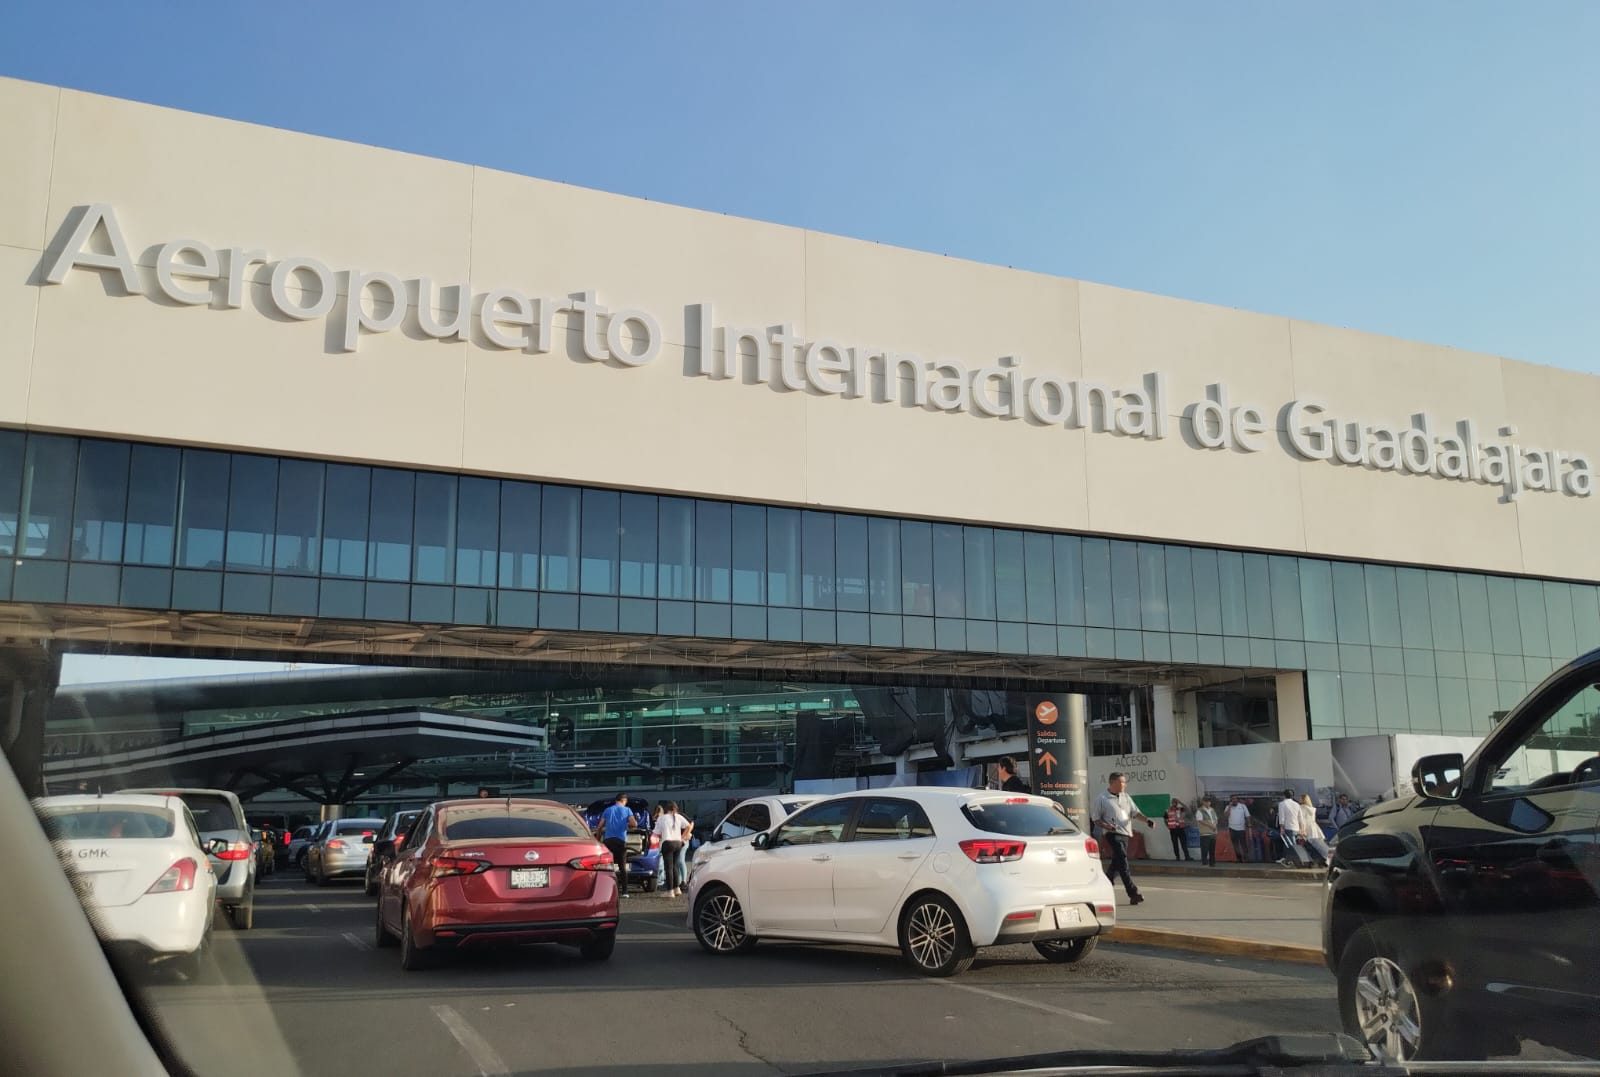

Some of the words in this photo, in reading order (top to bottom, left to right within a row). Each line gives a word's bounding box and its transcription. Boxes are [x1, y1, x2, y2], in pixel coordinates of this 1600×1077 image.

[45, 202, 661, 367] Aeropuerto
[698, 303, 1166, 440] Internacional
[1191, 382, 1267, 451] de
[1286, 400, 1591, 502] Guadalajara
[1115, 755, 1149, 768] ACCESO
